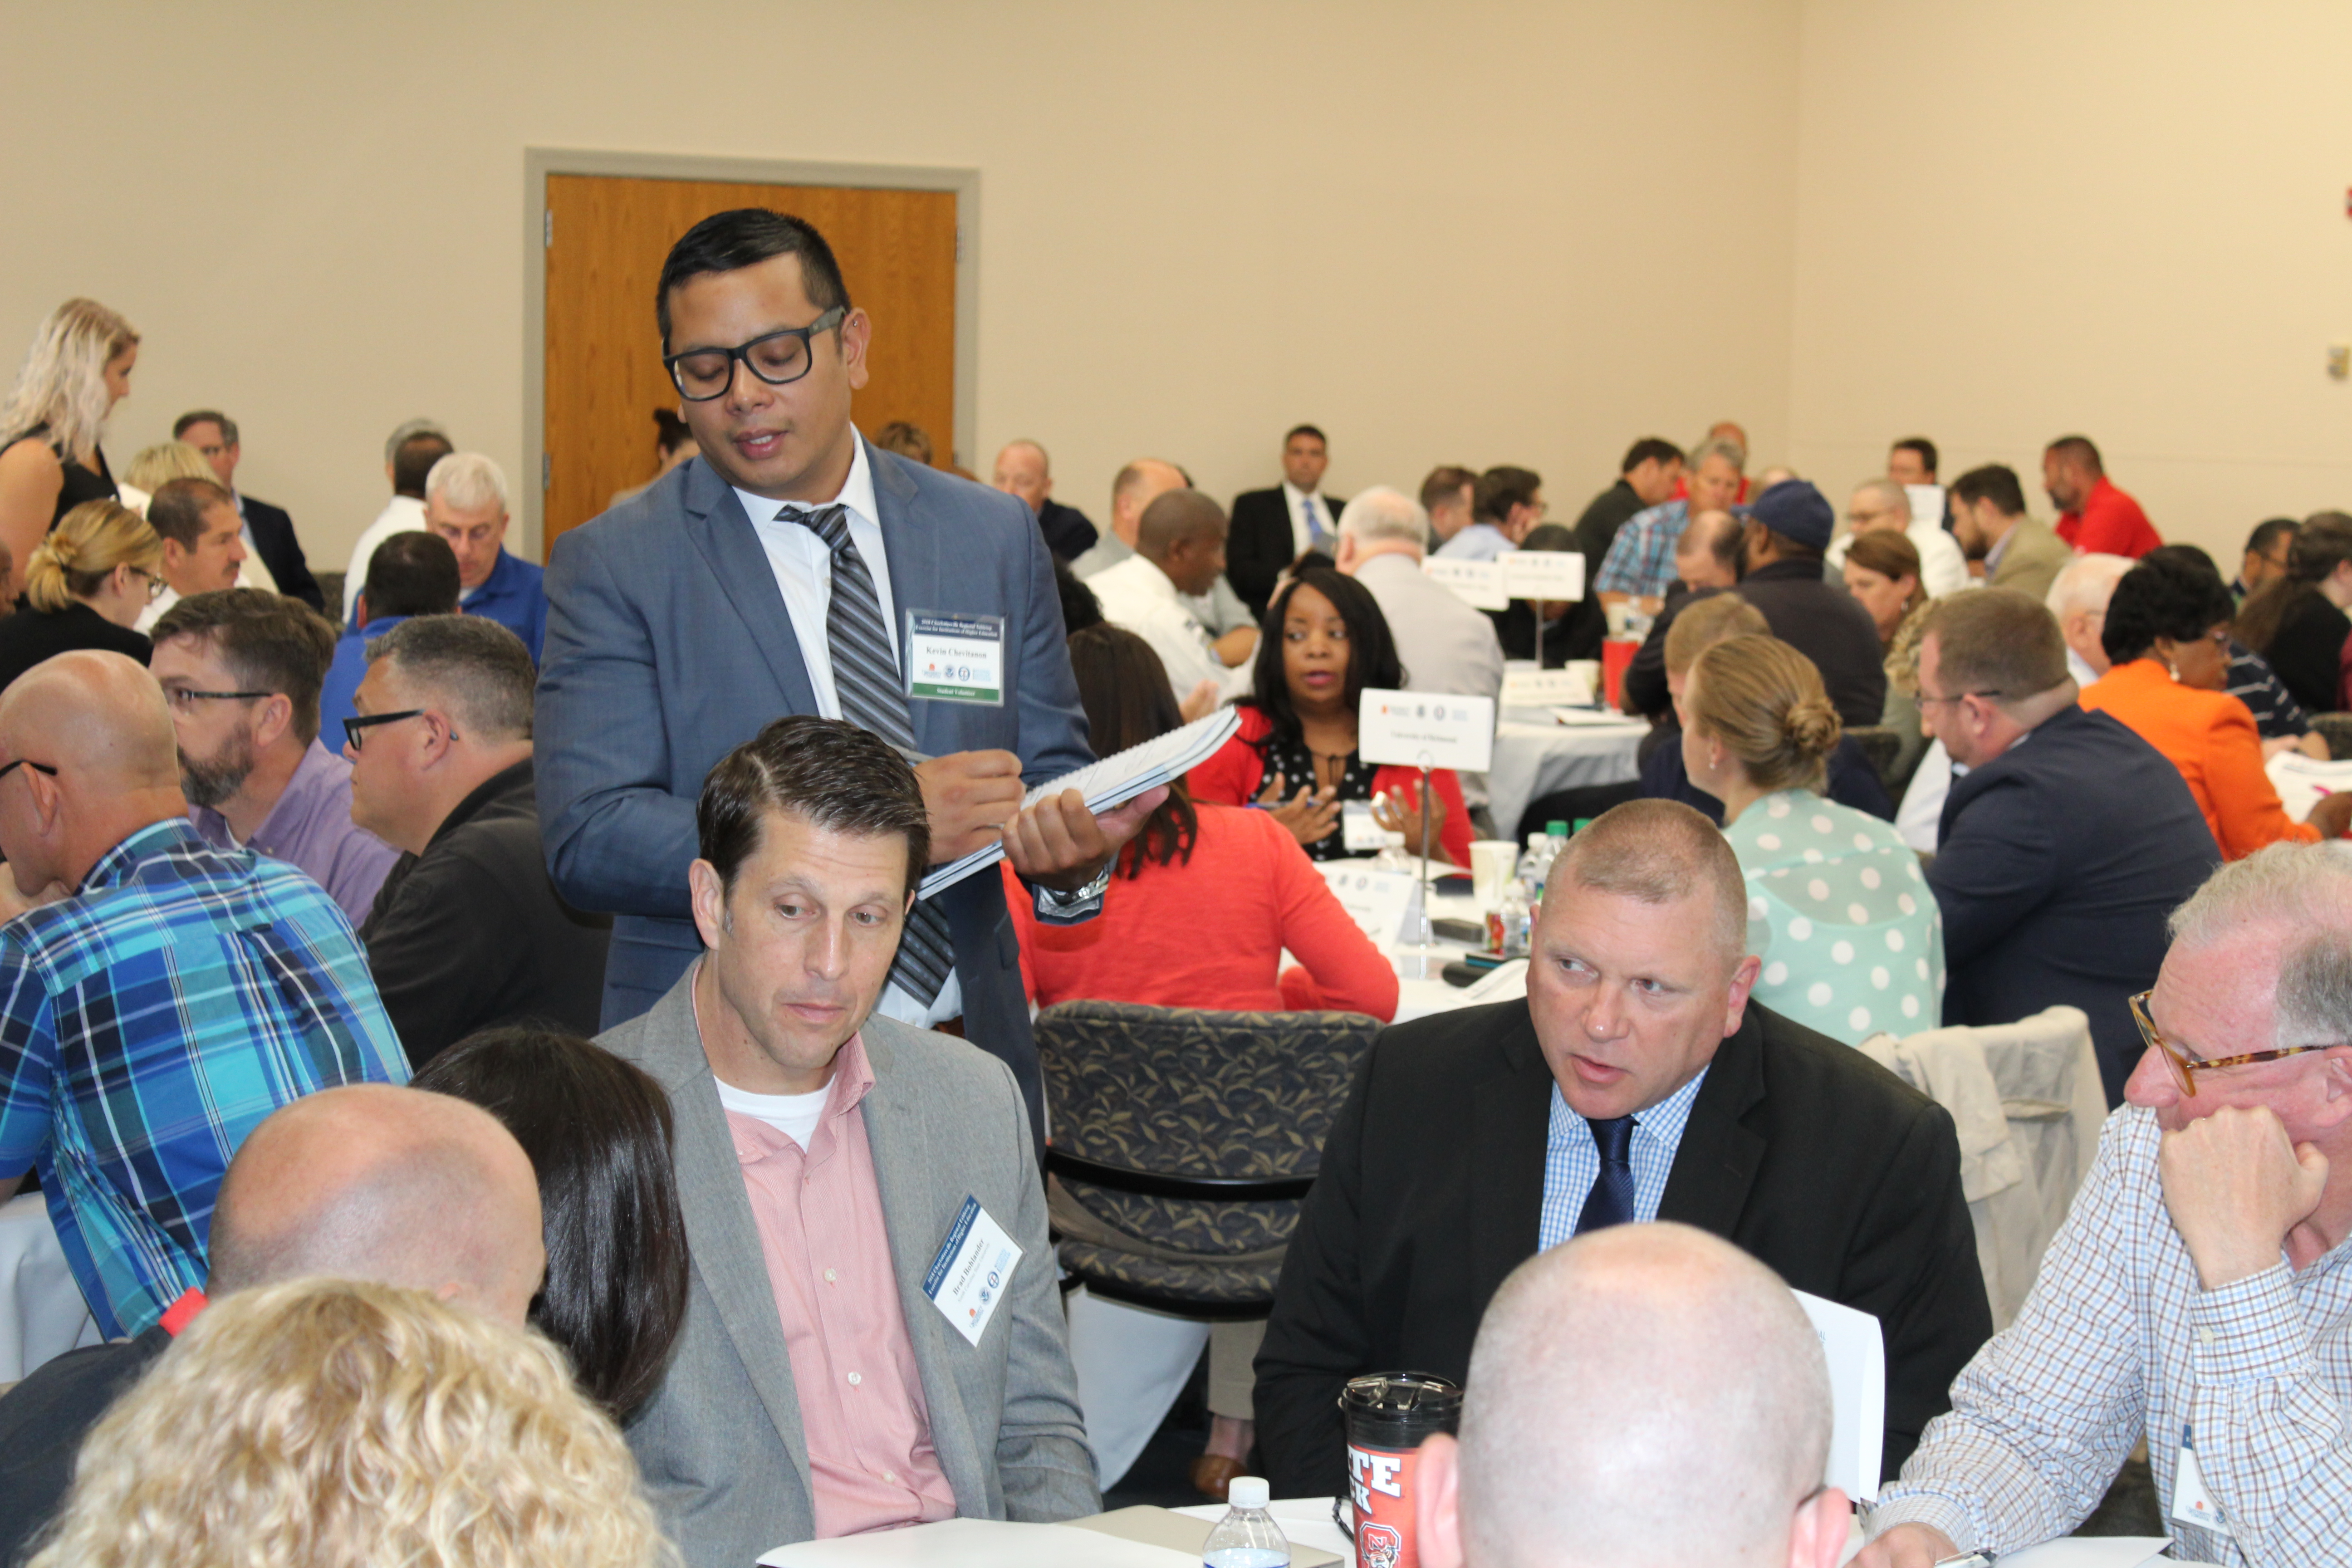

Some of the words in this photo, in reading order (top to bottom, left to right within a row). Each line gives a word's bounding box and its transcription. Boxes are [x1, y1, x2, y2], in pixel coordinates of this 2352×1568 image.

[926, 646, 946, 655] Kevin
[948, 648, 986, 658] Chevitanon
[928, 1276, 939, 1294] Exercise
[941, 1244, 956, 1269] Institutions
[956, 1225, 965, 1240] Higher
[964, 1203, 976, 1225] Education
[933, 1242, 951, 1273] Charlottesville
[950, 1222, 961, 1242] Regional
[959, 1204, 970, 1223] Tabletop
[953, 1275, 965, 1295] Brad
[963, 1239, 984, 1275] Bohlander
[1348, 1445, 1401, 1497] TE
